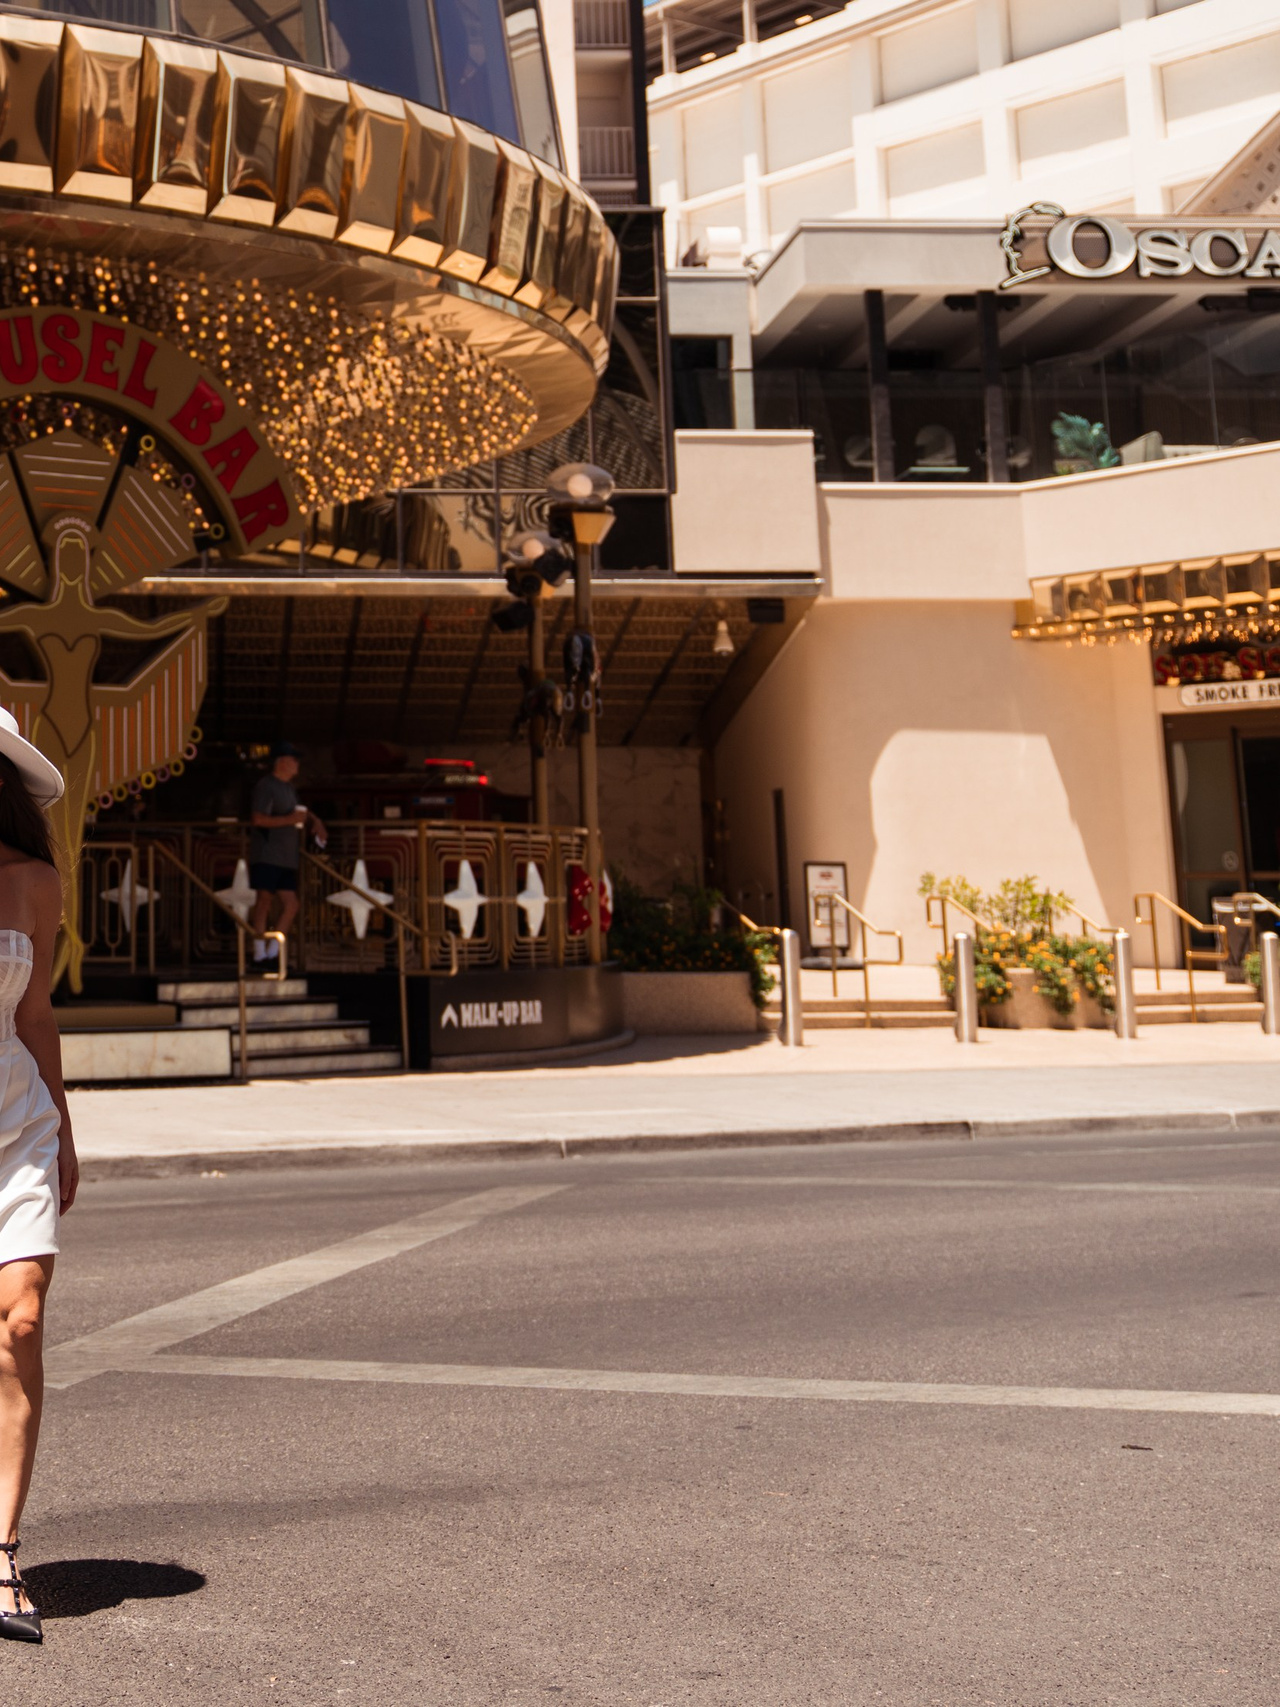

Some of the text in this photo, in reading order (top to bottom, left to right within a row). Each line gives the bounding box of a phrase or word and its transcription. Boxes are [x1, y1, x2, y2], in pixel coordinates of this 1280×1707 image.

[169, 377, 290, 543] BAR
[1196, 684, 1248, 702] SMOKE
[460, 1000, 542, 1027] WALK-UP BAR
